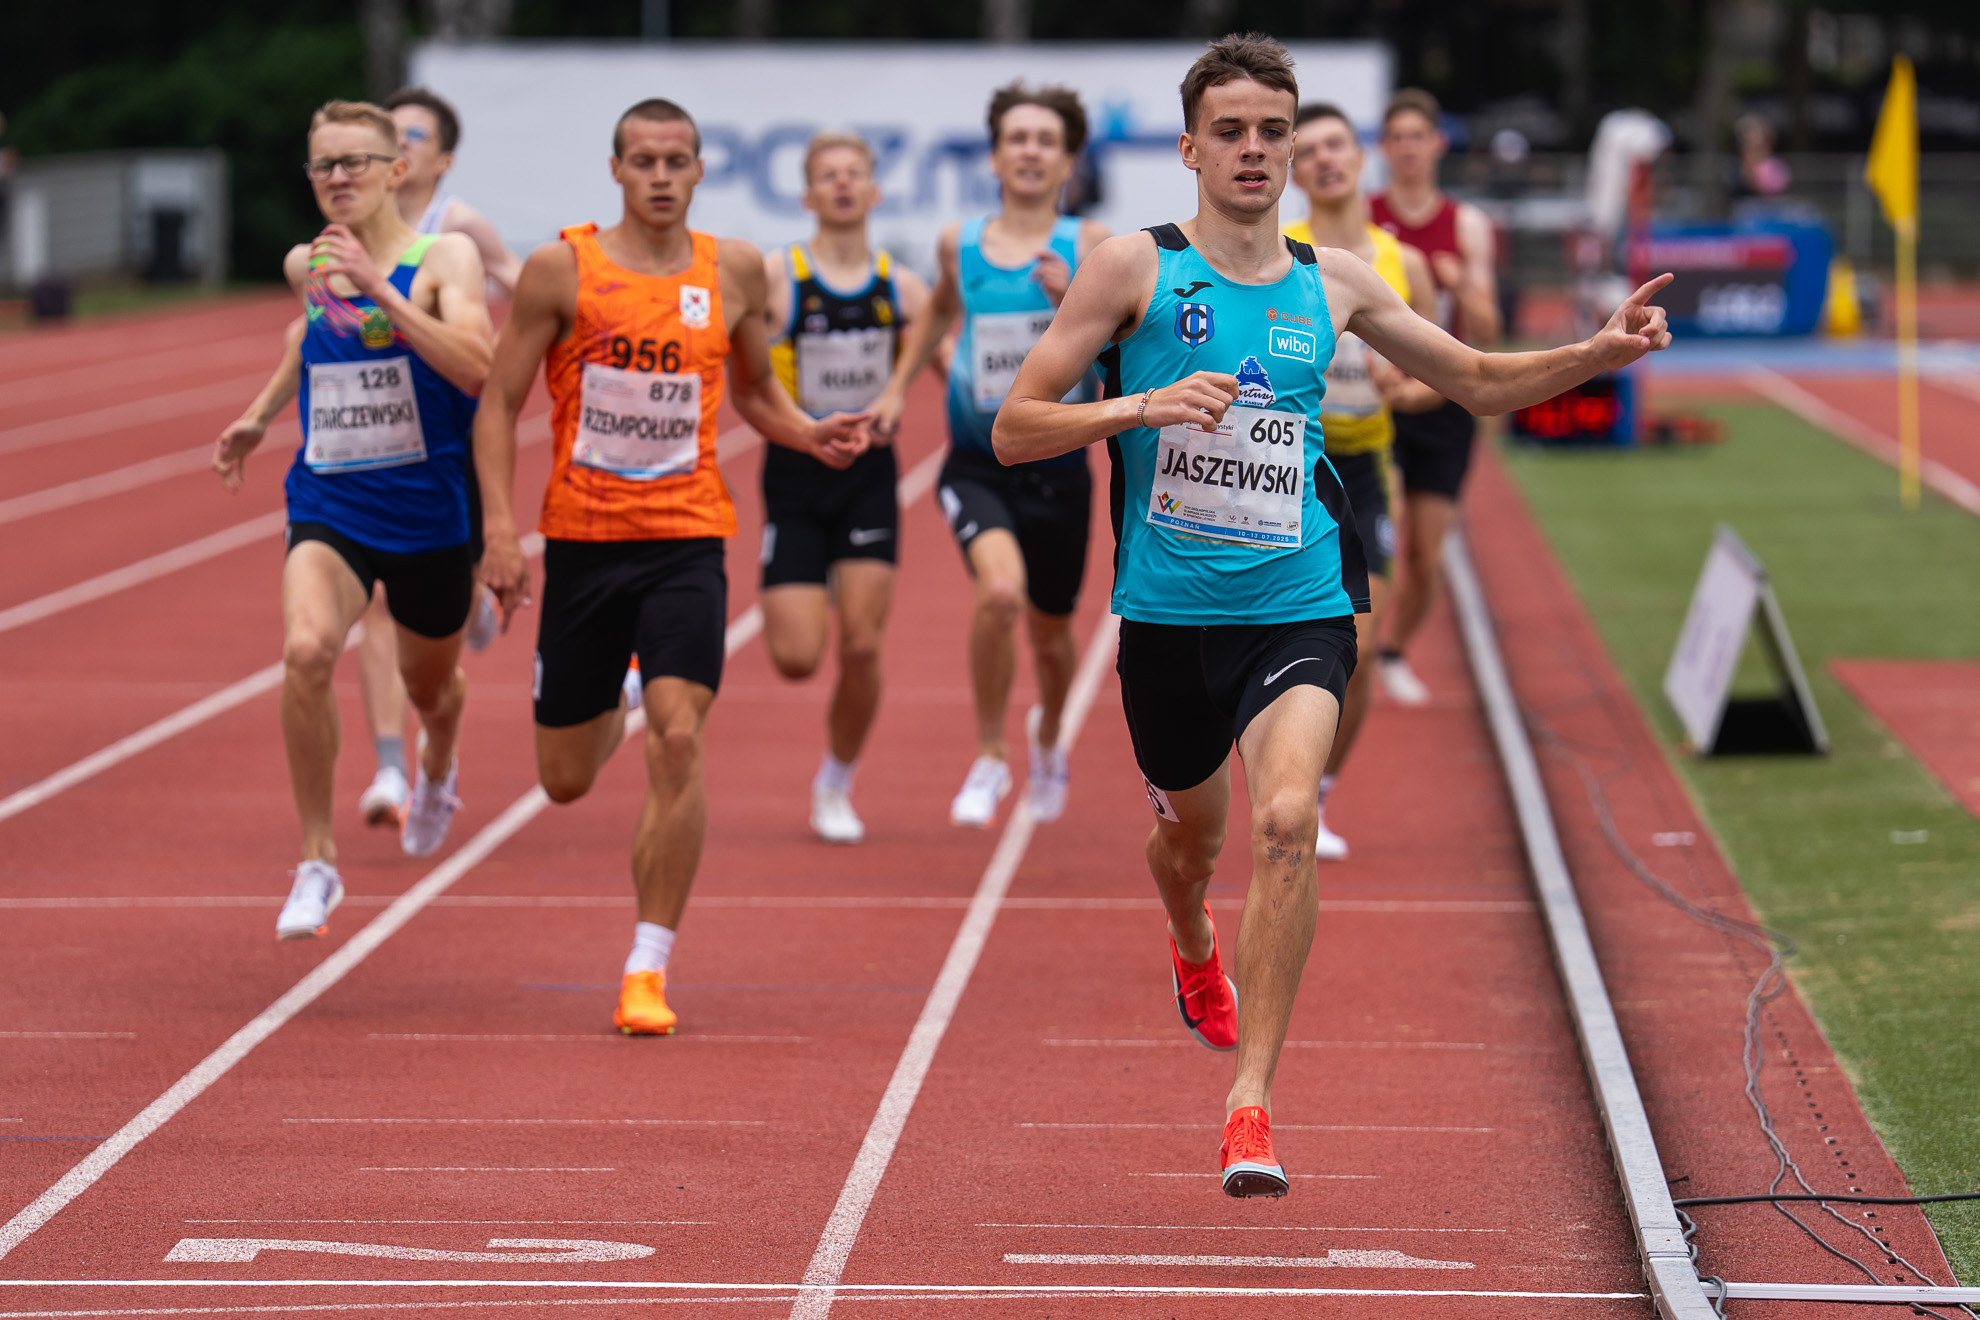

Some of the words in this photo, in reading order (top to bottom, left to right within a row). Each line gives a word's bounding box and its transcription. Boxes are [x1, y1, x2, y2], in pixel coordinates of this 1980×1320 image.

[1281, 312, 1313, 327] CUBE
[611, 335, 681, 374] 956
[1276, 335, 1310, 355] wibo
[358, 365, 401, 390] 128
[649, 381, 693, 404] 878
[584, 406, 697, 441] RZEMPOŁUCH
[1250, 418, 1295, 447] 605
[1161, 447, 1298, 496] JASZEWSKI
[1170, 518, 1200, 530] POZNAŃ
